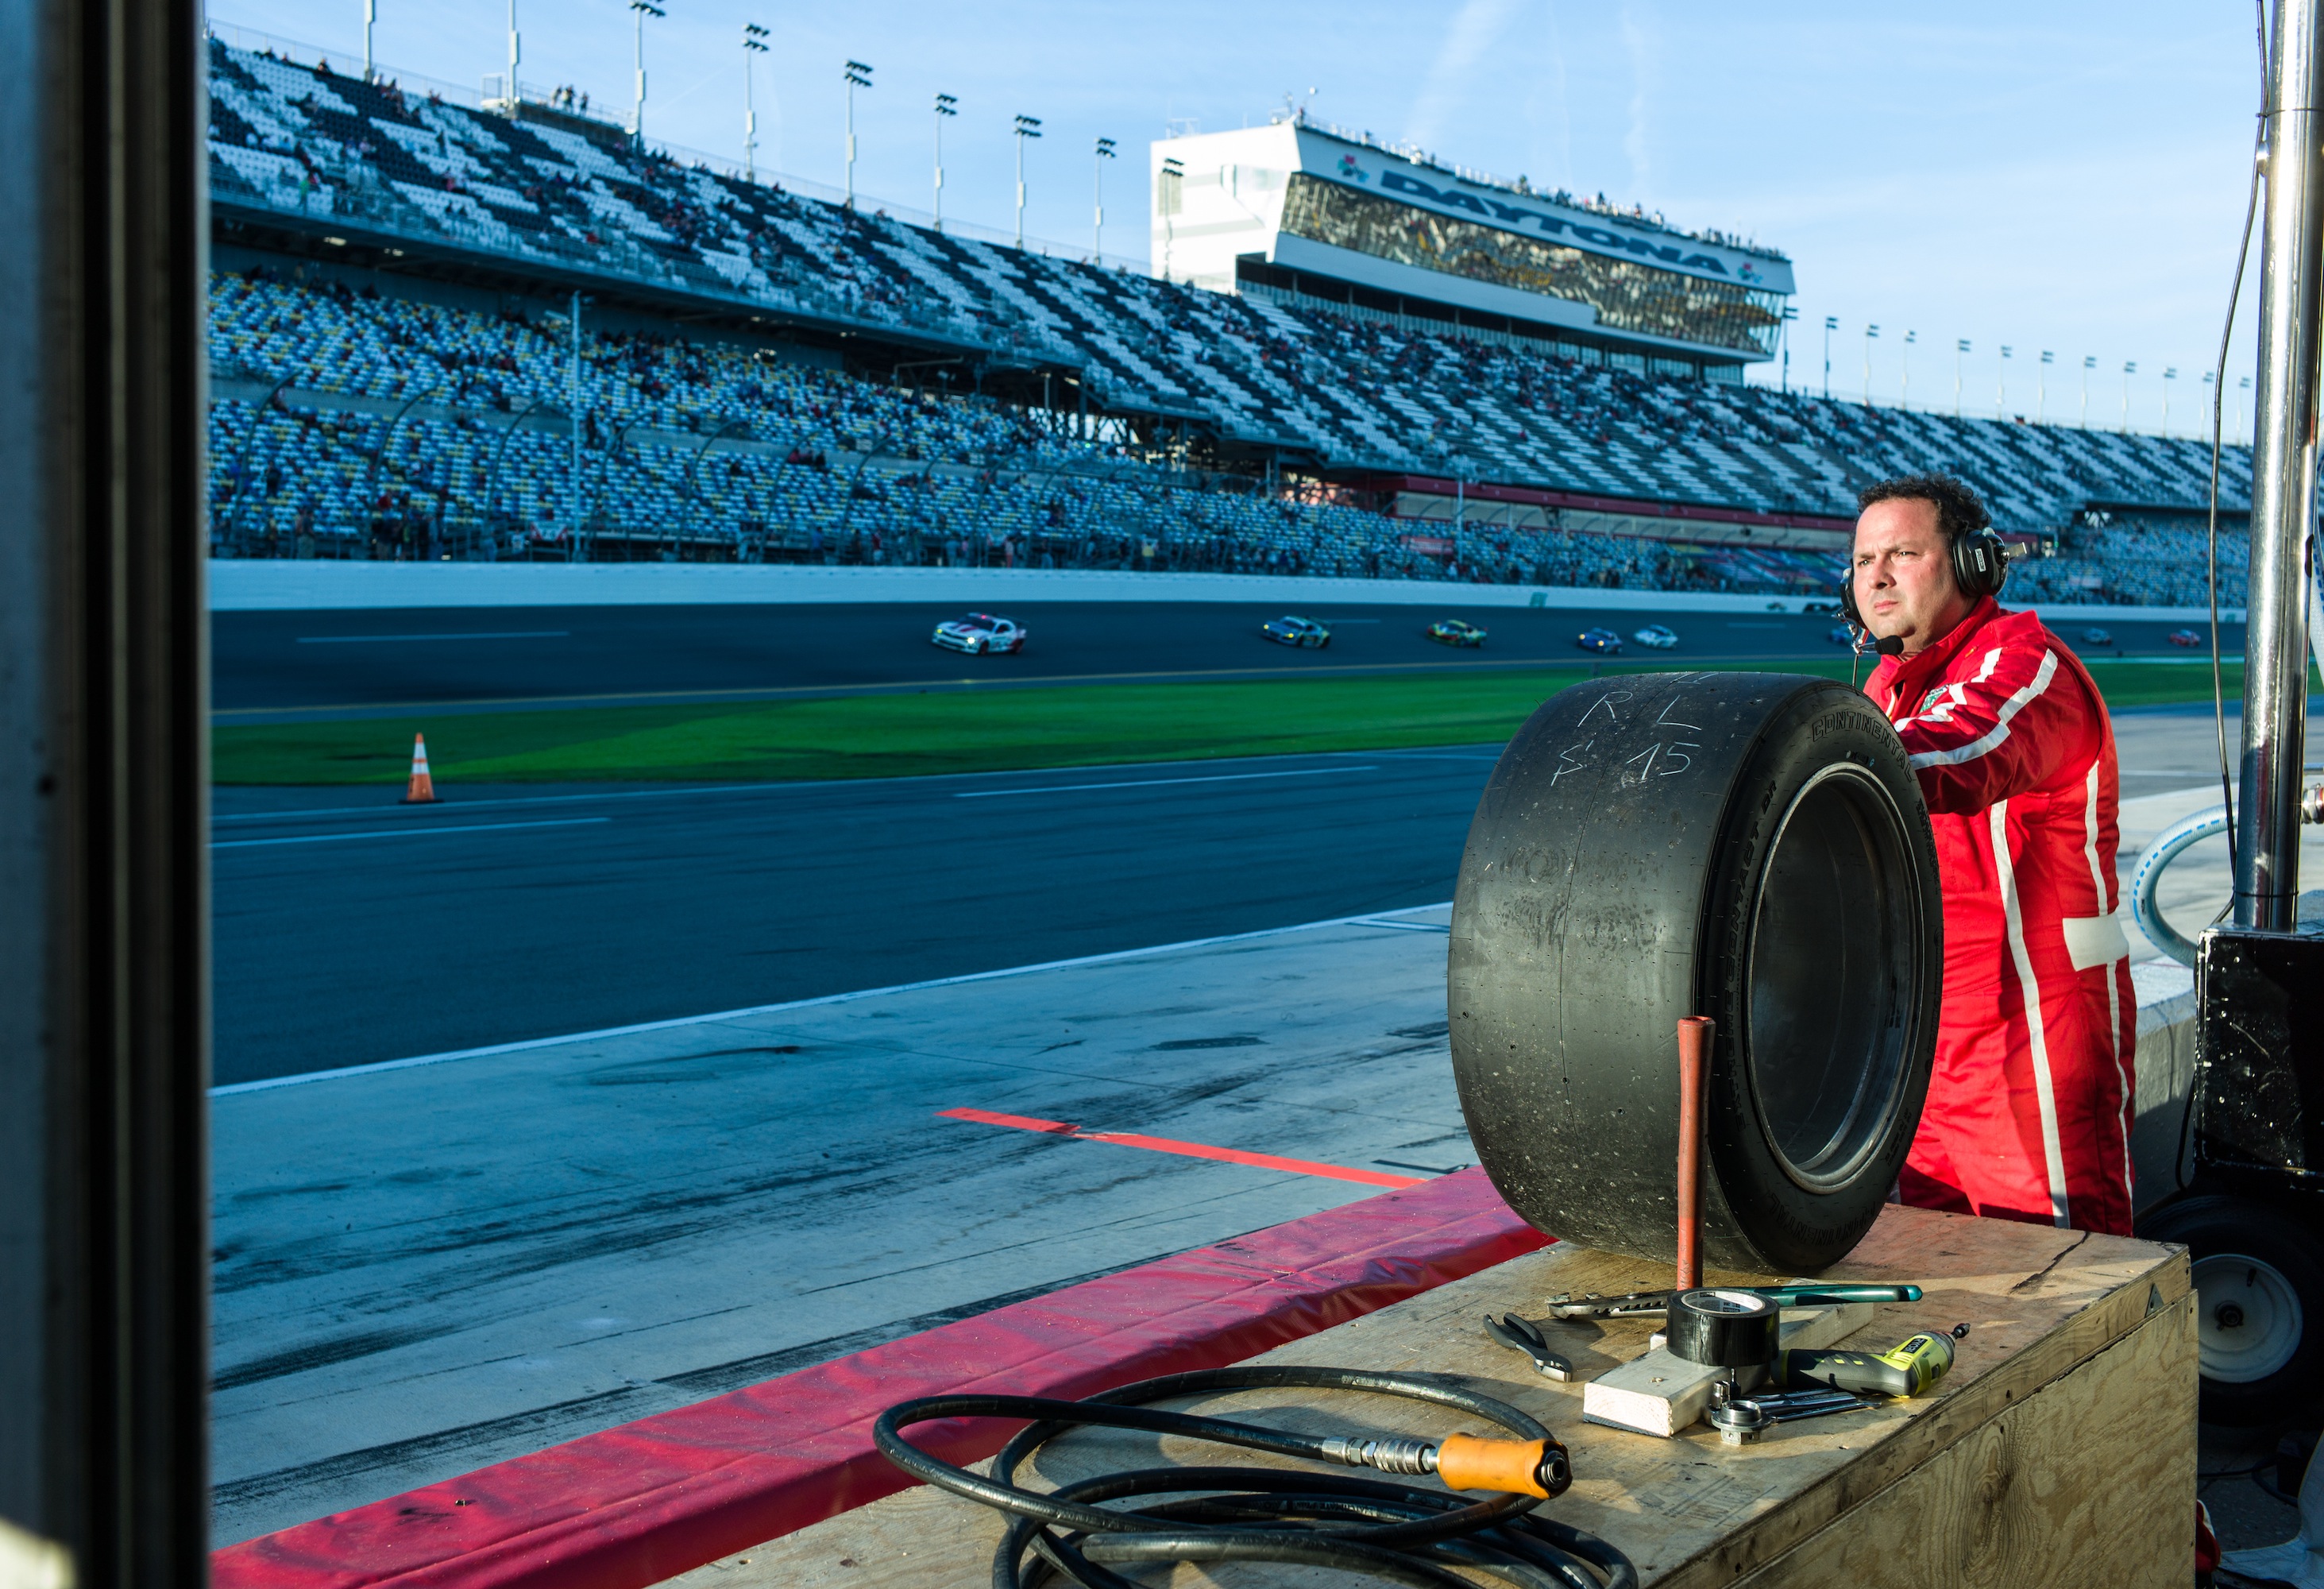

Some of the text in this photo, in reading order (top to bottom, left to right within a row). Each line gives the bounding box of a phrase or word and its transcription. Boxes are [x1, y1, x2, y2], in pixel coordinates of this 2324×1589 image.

[1380, 169, 1729, 275] DAYTONA
[1812, 711, 1913, 783] CONTINENTAL
[1725, 821, 1759, 982] CONTACT
[1724, 989, 1747, 1133] EXTREME
